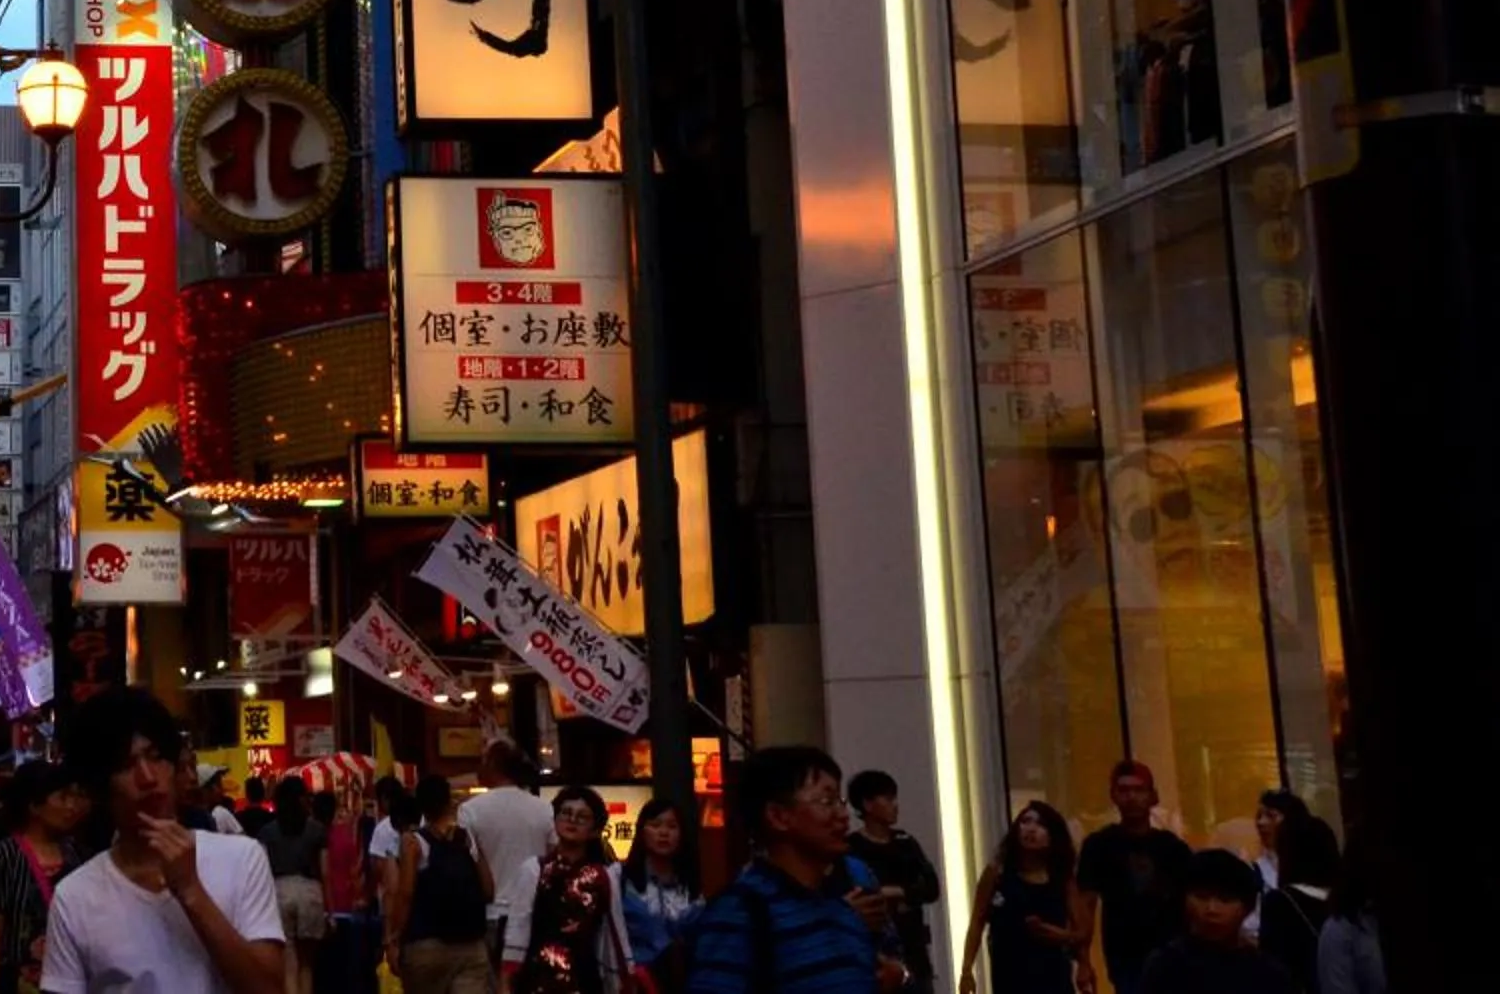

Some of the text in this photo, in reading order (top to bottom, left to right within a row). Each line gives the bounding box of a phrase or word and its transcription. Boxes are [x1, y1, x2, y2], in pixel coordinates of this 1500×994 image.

[97, 56, 155, 401] ツルハドラッグ
